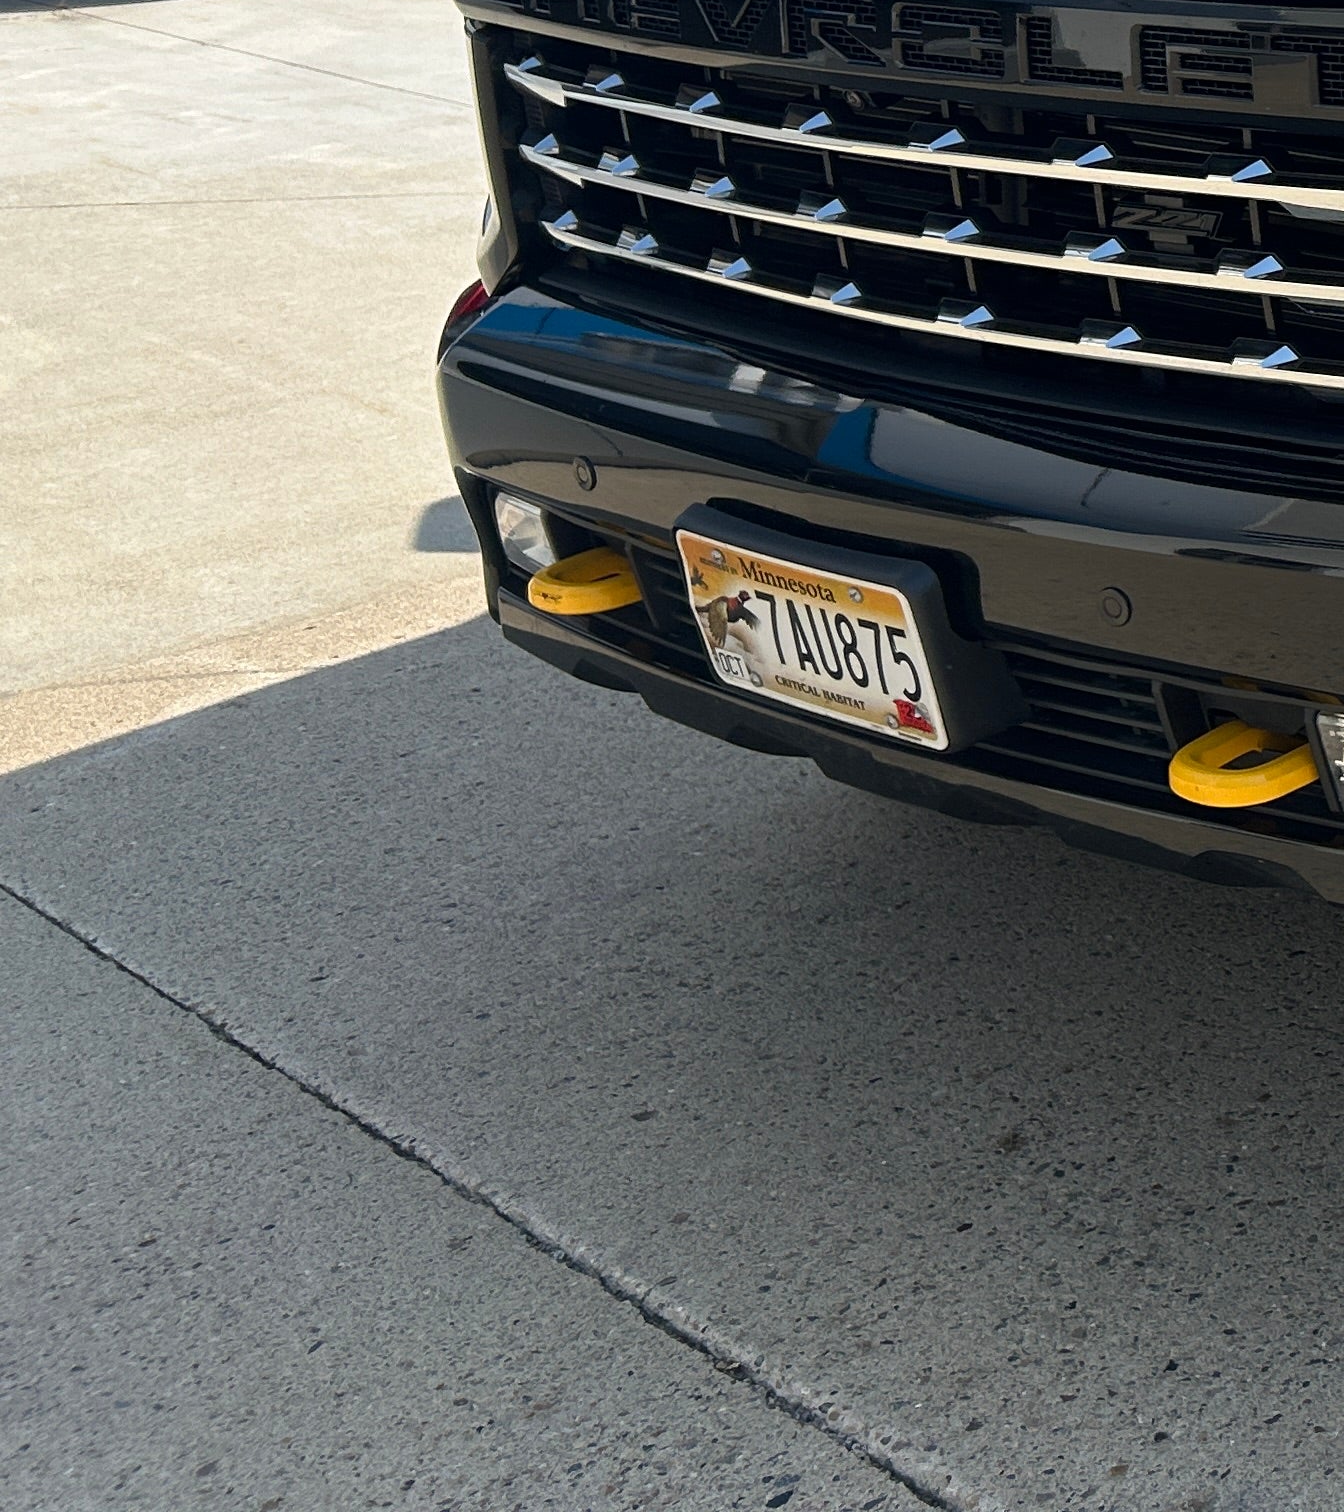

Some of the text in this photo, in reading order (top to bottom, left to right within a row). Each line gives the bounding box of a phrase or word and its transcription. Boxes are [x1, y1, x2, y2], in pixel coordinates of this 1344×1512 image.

[737, 556, 837, 604] Minnesota
[718, 652, 745, 678] OCT
[754, 589, 922, 702] 7AU875
[774, 674, 867, 711] CRITICAL HABITAT
